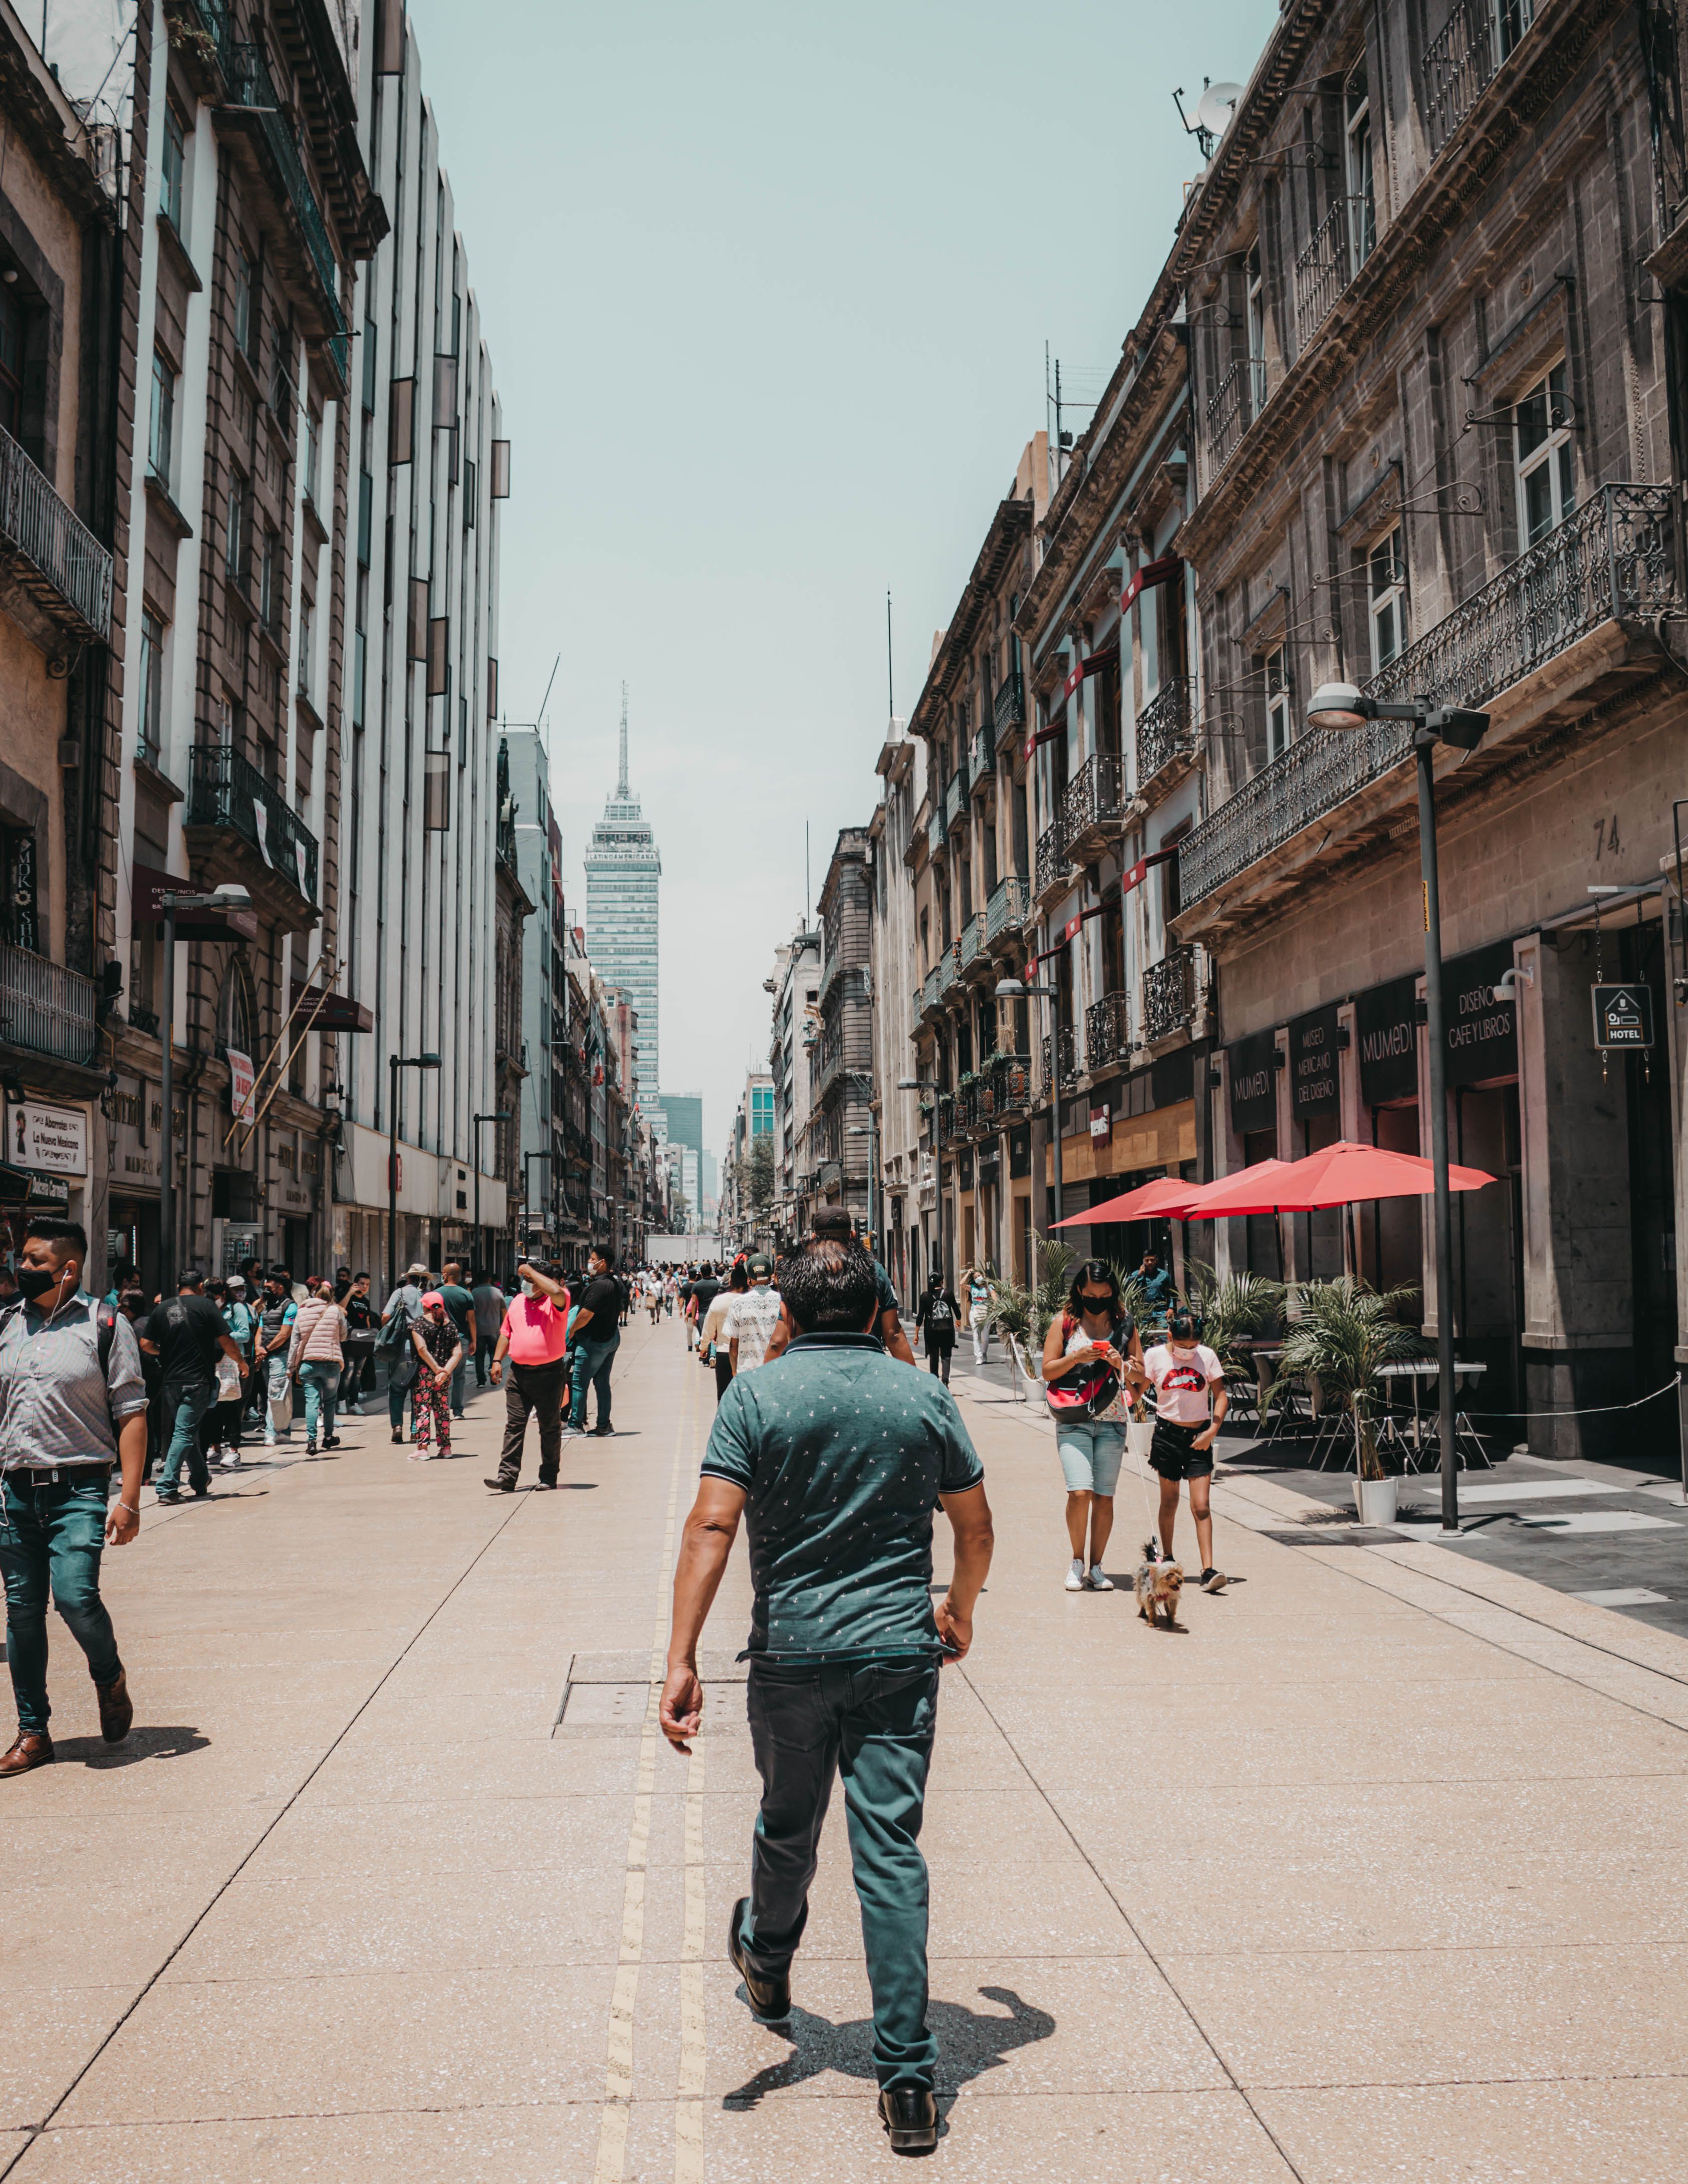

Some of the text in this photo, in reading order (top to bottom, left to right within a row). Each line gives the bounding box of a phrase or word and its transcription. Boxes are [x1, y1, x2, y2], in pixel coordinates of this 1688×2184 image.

[594, 833, 650, 843] 13:04:49
[1594, 814, 1619, 861] 74
[20, 911, 34, 953] SHO
[1459, 986, 1495, 1014] DISEÑO
[1303, 1027, 1324, 1048] MUSEO
[1449, 1012, 1511, 1048] CAFE Y LIBROS
[1610, 1030, 1640, 1038] HOTEL
[1299, 1052, 1331, 1076] MEXICANO
[1299, 1078, 1334, 1103] DEL DISEÑO
[33, 1131, 79, 1150] La Nueva Mexicana
